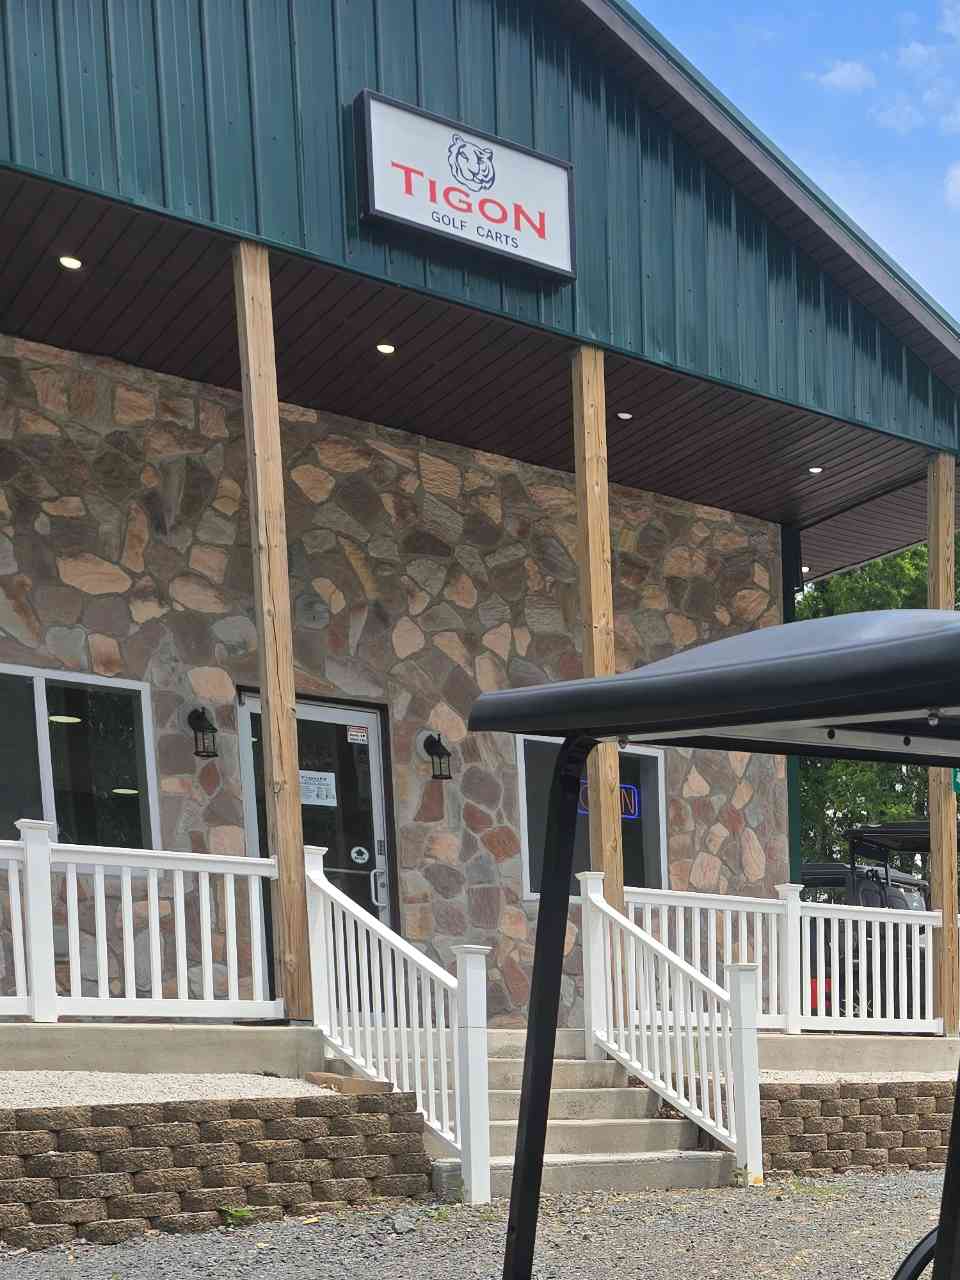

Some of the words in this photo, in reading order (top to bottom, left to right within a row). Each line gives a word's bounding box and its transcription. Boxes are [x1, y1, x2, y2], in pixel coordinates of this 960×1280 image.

[390, 161, 547, 240] TIGON
[431, 211, 467, 231] GOLF
[476, 226, 520, 249] CARTS
